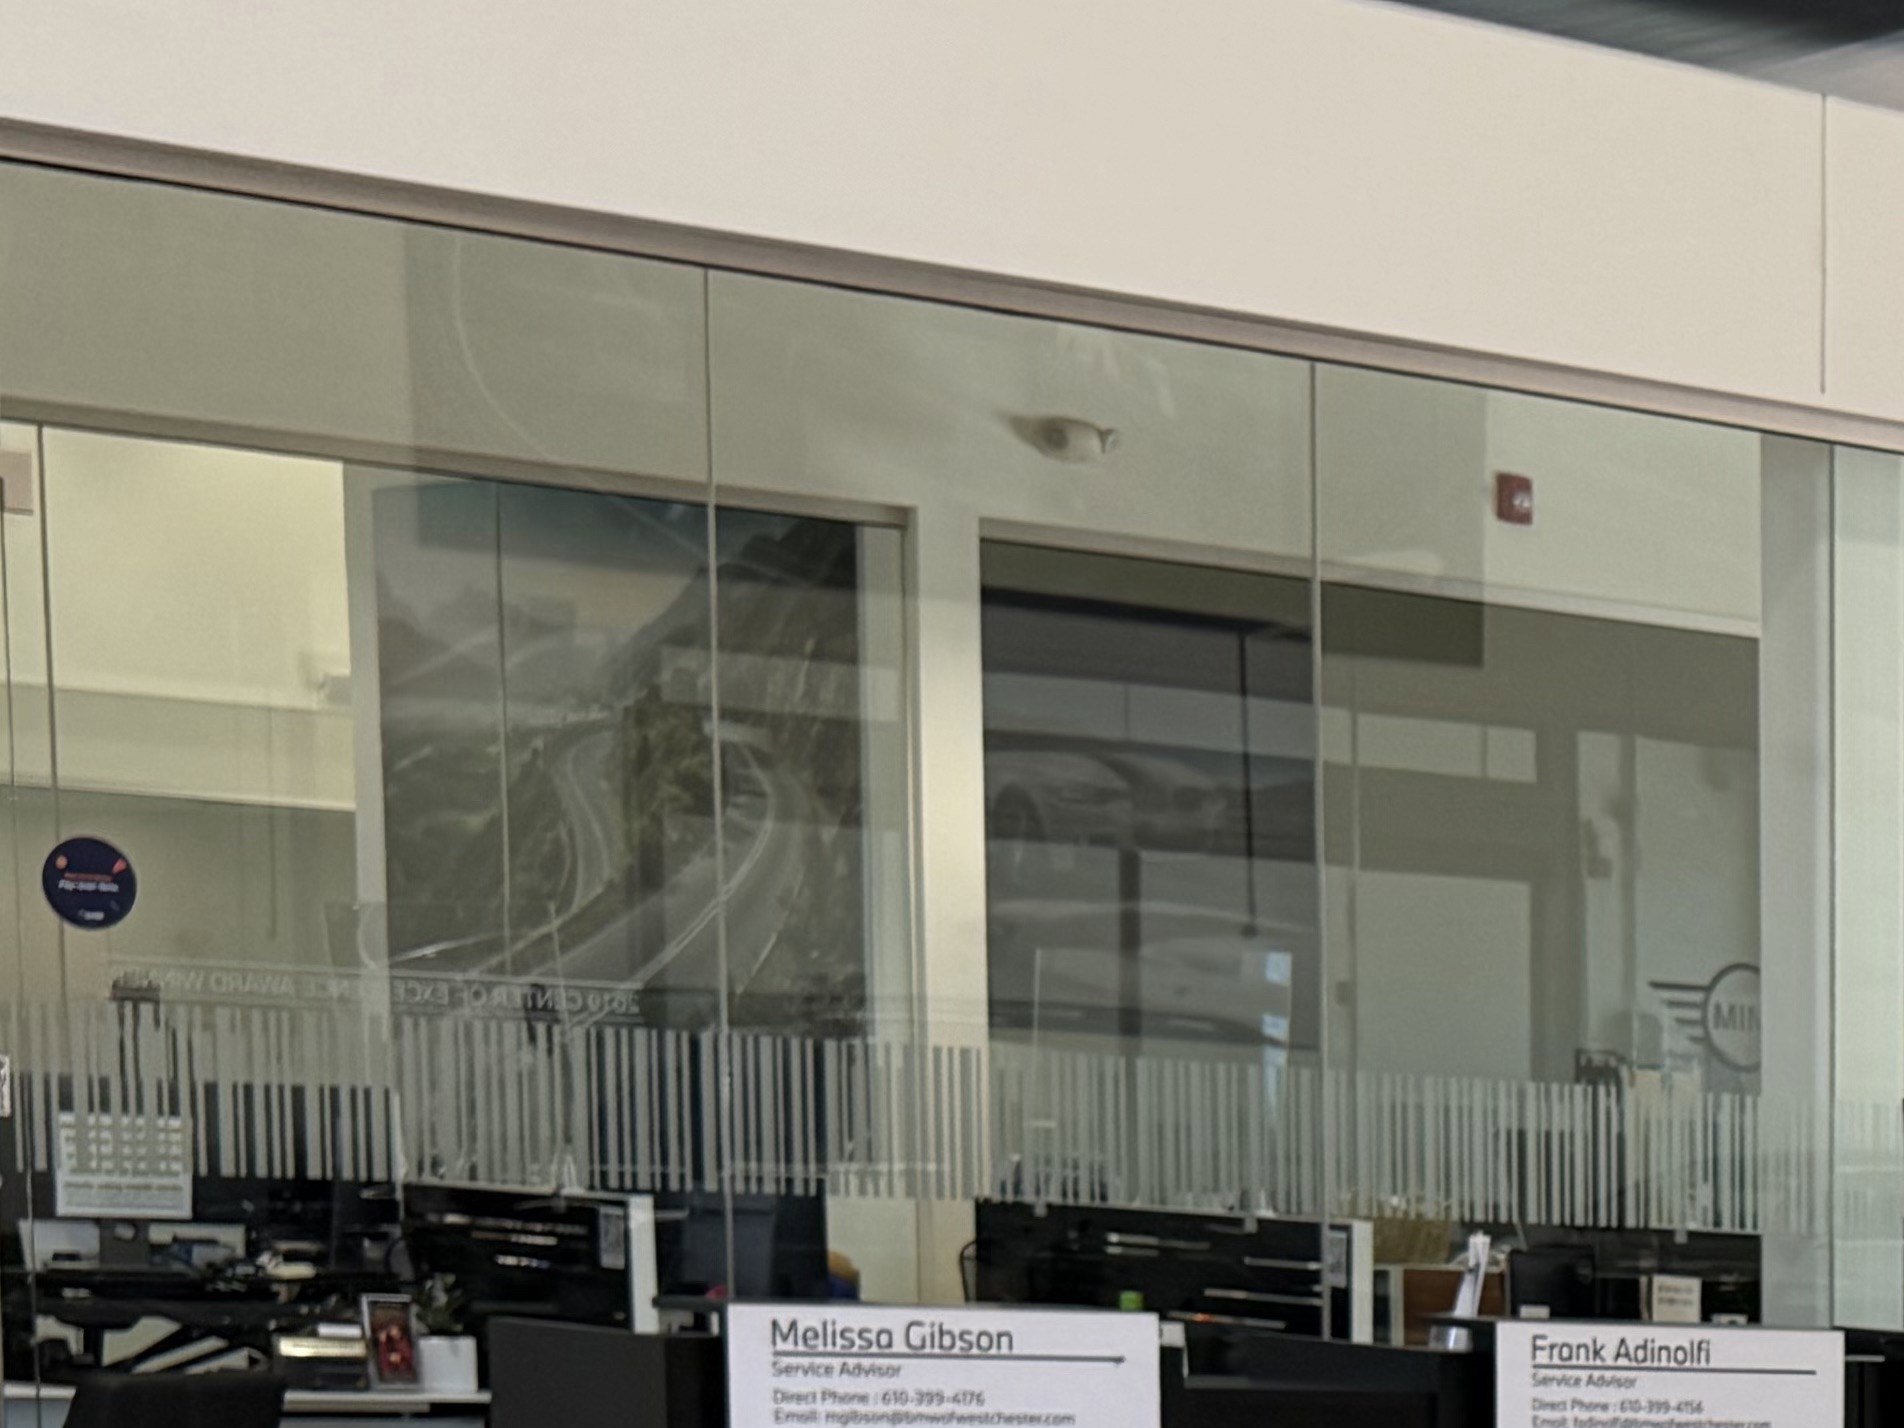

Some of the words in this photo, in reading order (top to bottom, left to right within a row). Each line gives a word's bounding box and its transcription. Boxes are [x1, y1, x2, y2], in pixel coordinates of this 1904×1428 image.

[1713, 1001, 1759, 1031] MIN
[770, 1318, 893, 1350] Melissa
[904, 1320, 1014, 1352] Gibson
[1530, 1334, 1607, 1363] Frank
[1613, 1336, 1711, 1365] Adinolfi
[771, 1362, 834, 1378] Service
[838, 1363, 902, 1379] Advisor
[1532, 1373, 1582, 1388] Service
[1585, 1374, 1637, 1389] Advisor
[773, 1389, 816, 1405] Direct
[822, 1390, 868, 1405] Phone
[1532, 1398, 1567, 1412] Direct
[1571, 1399, 1609, 1413] Phone
